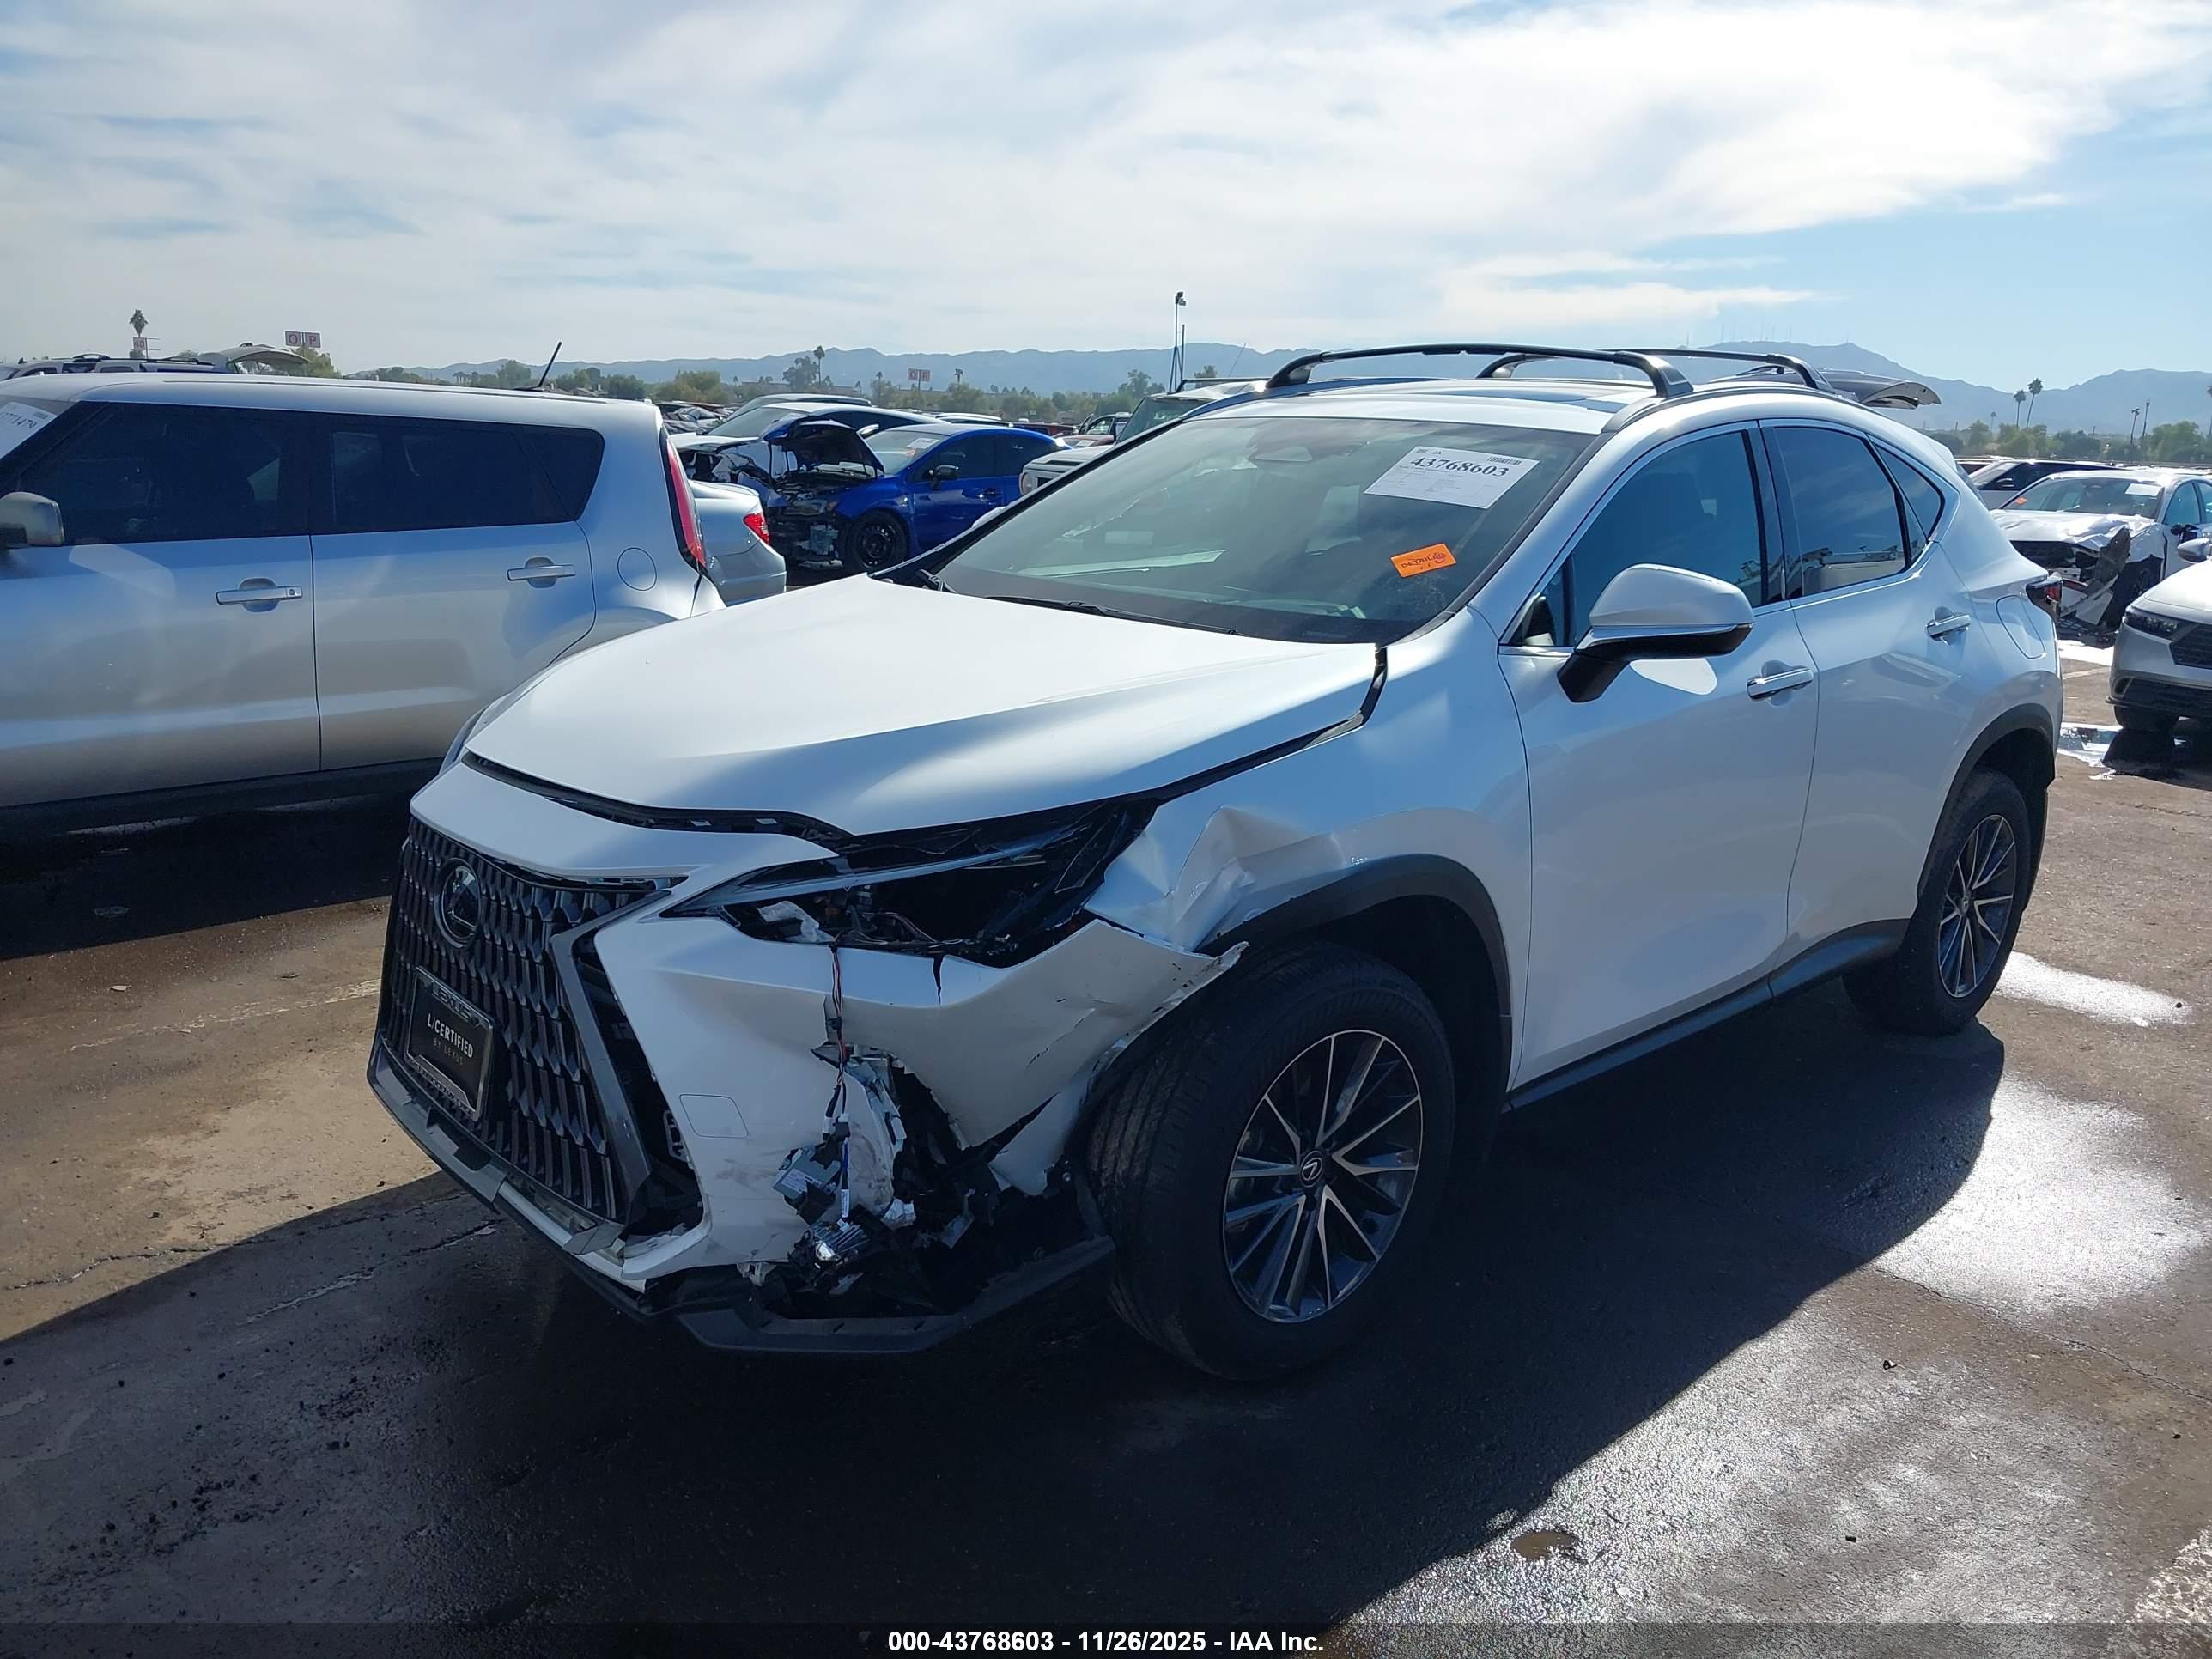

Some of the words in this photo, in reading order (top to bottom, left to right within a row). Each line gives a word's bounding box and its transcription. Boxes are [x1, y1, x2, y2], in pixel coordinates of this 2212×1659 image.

[288, 334, 298, 344] O
[309, 335, 317, 345] P
[1410, 457, 1510, 477] 43768603
[427, 1012, 474, 1059] L/CERTIFIED
